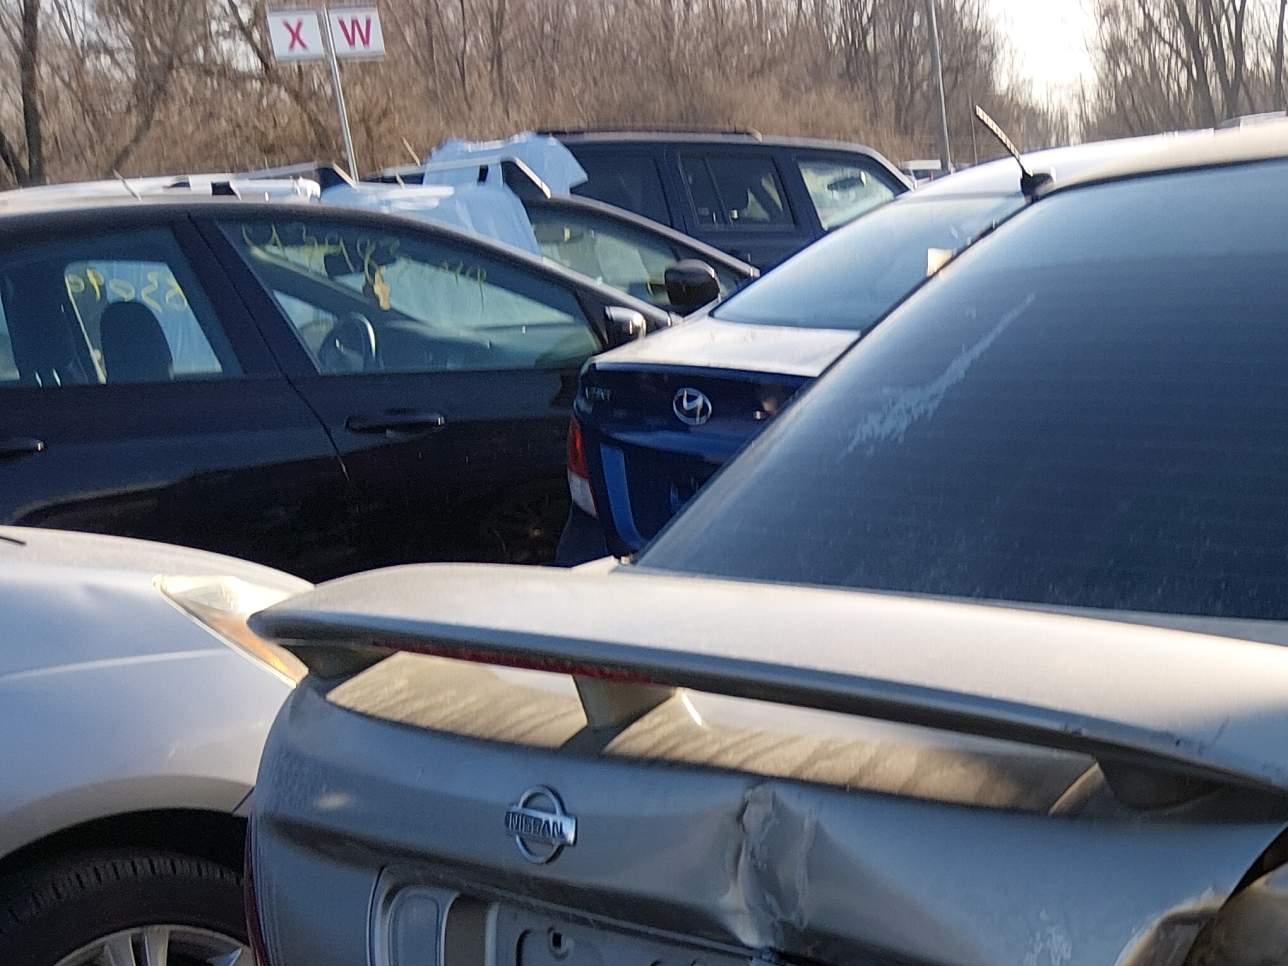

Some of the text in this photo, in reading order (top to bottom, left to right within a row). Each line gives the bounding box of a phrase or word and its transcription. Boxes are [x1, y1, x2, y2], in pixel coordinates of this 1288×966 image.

[282, 19, 308, 51] X
[338, 15, 371, 49] W
[506, 810, 564, 840] NISSAN
